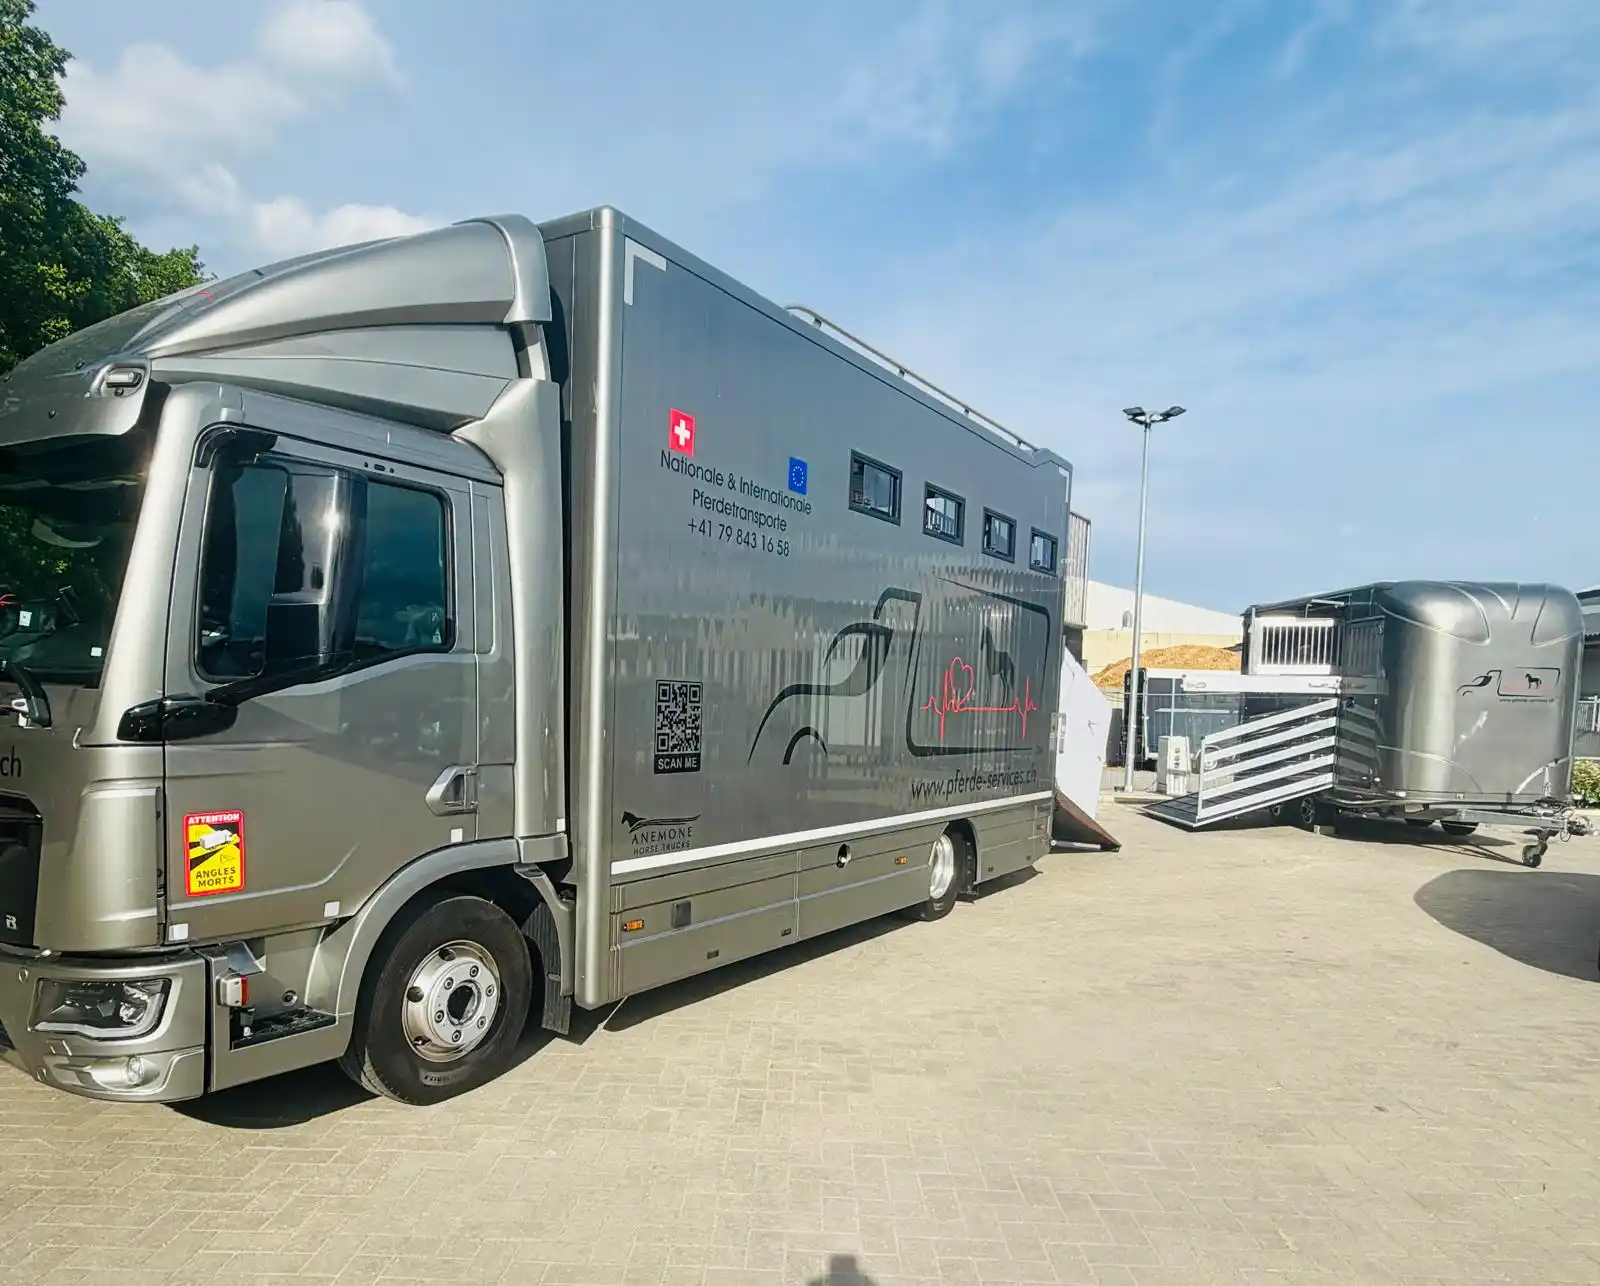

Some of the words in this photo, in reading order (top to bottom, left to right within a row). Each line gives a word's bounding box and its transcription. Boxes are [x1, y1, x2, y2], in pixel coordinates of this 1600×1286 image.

[660, 449, 724, 487] Nationale
[727, 472, 736, 491] &
[739, 475, 812, 516] Internationale
[692, 488, 787, 532] Pferdetransporte
[687, 517, 713, 538] +41
[718, 523, 733, 542] 79
[736, 528, 757, 549] 843
[761, 534, 774, 553] 16
[777, 539, 790, 557] 58
[0, 745, 21, 777] ch
[658, 757, 683, 770] SCAN
[684, 756, 698, 769] ME
[911, 761, 1037, 802] www.pferde-services.ch
[188, 812, 240, 825] ATTENTION
[631, 826, 693, 845] ANEMONE
[633, 844, 658, 856] HORSE
[662, 840, 690, 852] TRUCKS
[195, 866, 236, 880] ANGLES
[197, 875, 235, 888] MORTS
